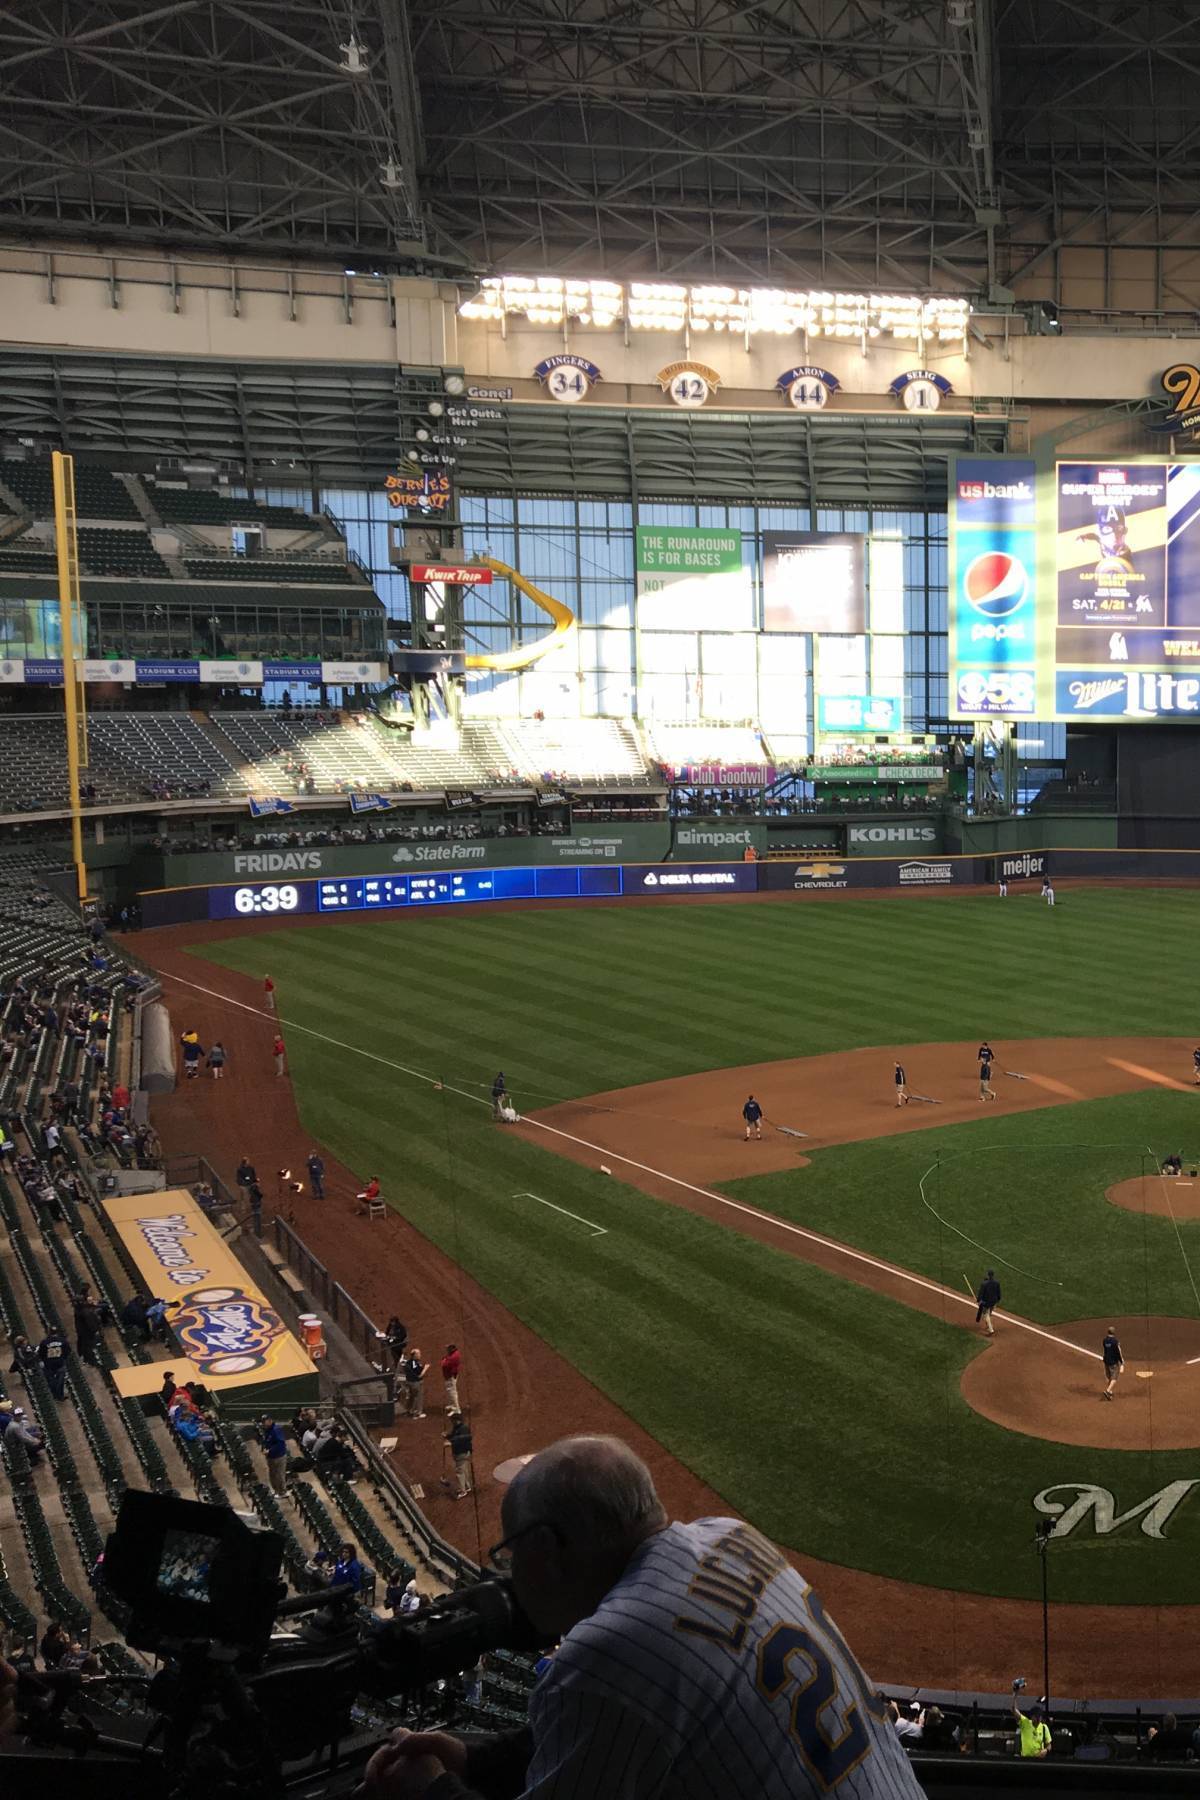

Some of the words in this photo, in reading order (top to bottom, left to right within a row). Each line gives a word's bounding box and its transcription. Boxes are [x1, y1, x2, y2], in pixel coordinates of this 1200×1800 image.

[544, 355, 591, 371] FINGERS
[791, 366, 826, 379] AARON
[906, 370, 936, 382] SELIG
[553, 371, 584, 395] 34
[674, 379, 705, 399] 42
[468, 387, 513, 399] Gone!
[794, 383, 823, 403] 44
[917, 388, 928, 407] 1
[447, 408, 467, 418] Get
[469, 408, 501, 418] Outta
[452, 418, 478, 427] Here
[432, 435, 450, 445] Get
[453, 436, 467, 446] Up
[421, 455, 439, 464] Get
[441, 455, 456, 465] Up
[642, 536, 664, 550] THE
[667, 536, 736, 552] RUNAROUND
[643, 551, 654, 565] IS
[658, 552, 681, 565] FOR
[685, 553, 721, 566] BASES
[424, 568, 455, 581] KWIK
[456, 569, 482, 582] TRIP
[643, 579, 665, 591] NOT
[1072, 599, 1098, 611] SAT,
[1100, 599, 1125, 611] 4/21
[987, 673, 1034, 704] 58
[1069, 679, 1126, 708] Miller
[1123, 672, 1200, 717] Lite
[691, 767, 715, 785] Club
[718, 767, 768, 785] Goodwill
[885, 768, 914, 778] CHECK
[916, 768, 938, 777] DECK
[691, 828, 751, 846] impact
[851, 828, 936, 841] KOHL'S
[234, 852, 322, 873] FRIDAYS
[1003, 855, 1044, 878] meijer
[794, 880, 848, 889] CHEVROLET
[234, 885, 298, 913] 6:39
[136, 1214, 197, 1268] Welcome
[168, 1268, 210, 1286] to
